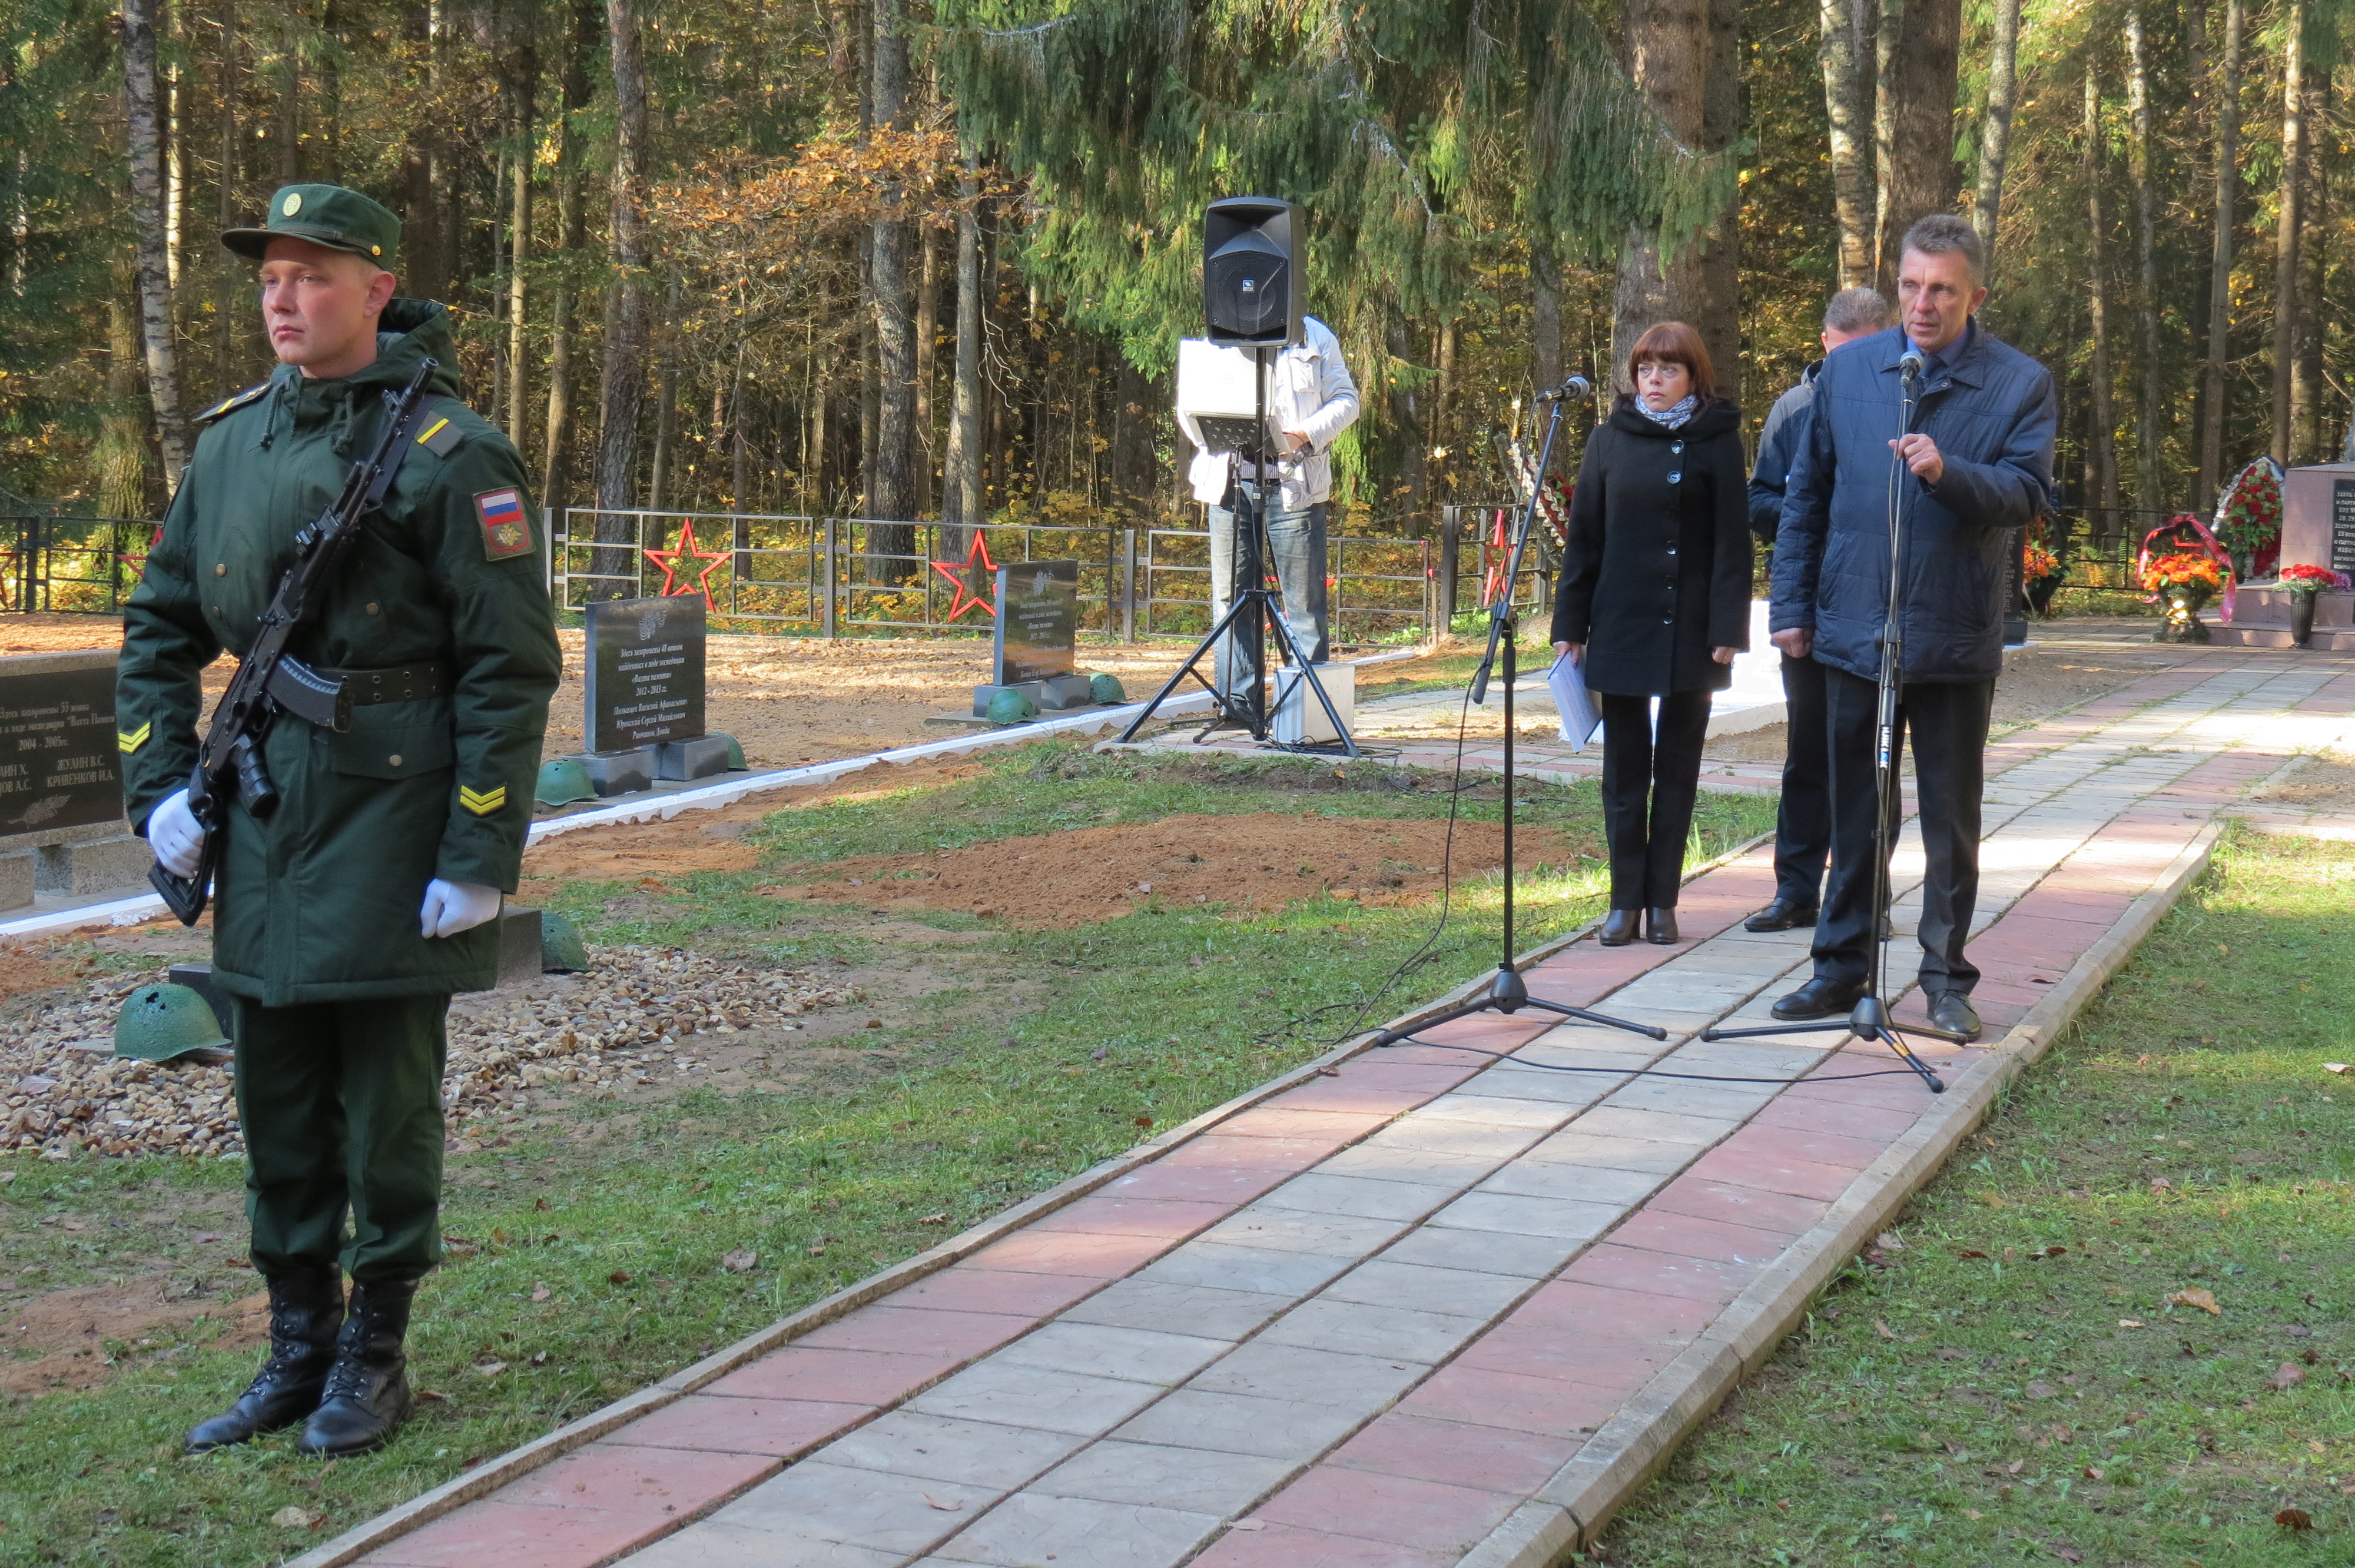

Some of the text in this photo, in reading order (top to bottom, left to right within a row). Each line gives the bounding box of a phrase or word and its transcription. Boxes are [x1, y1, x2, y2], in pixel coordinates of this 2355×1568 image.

[18, 738, 37, 750] 2004
[47, 769, 115, 788] КРИВЕНКОВ И.А.
